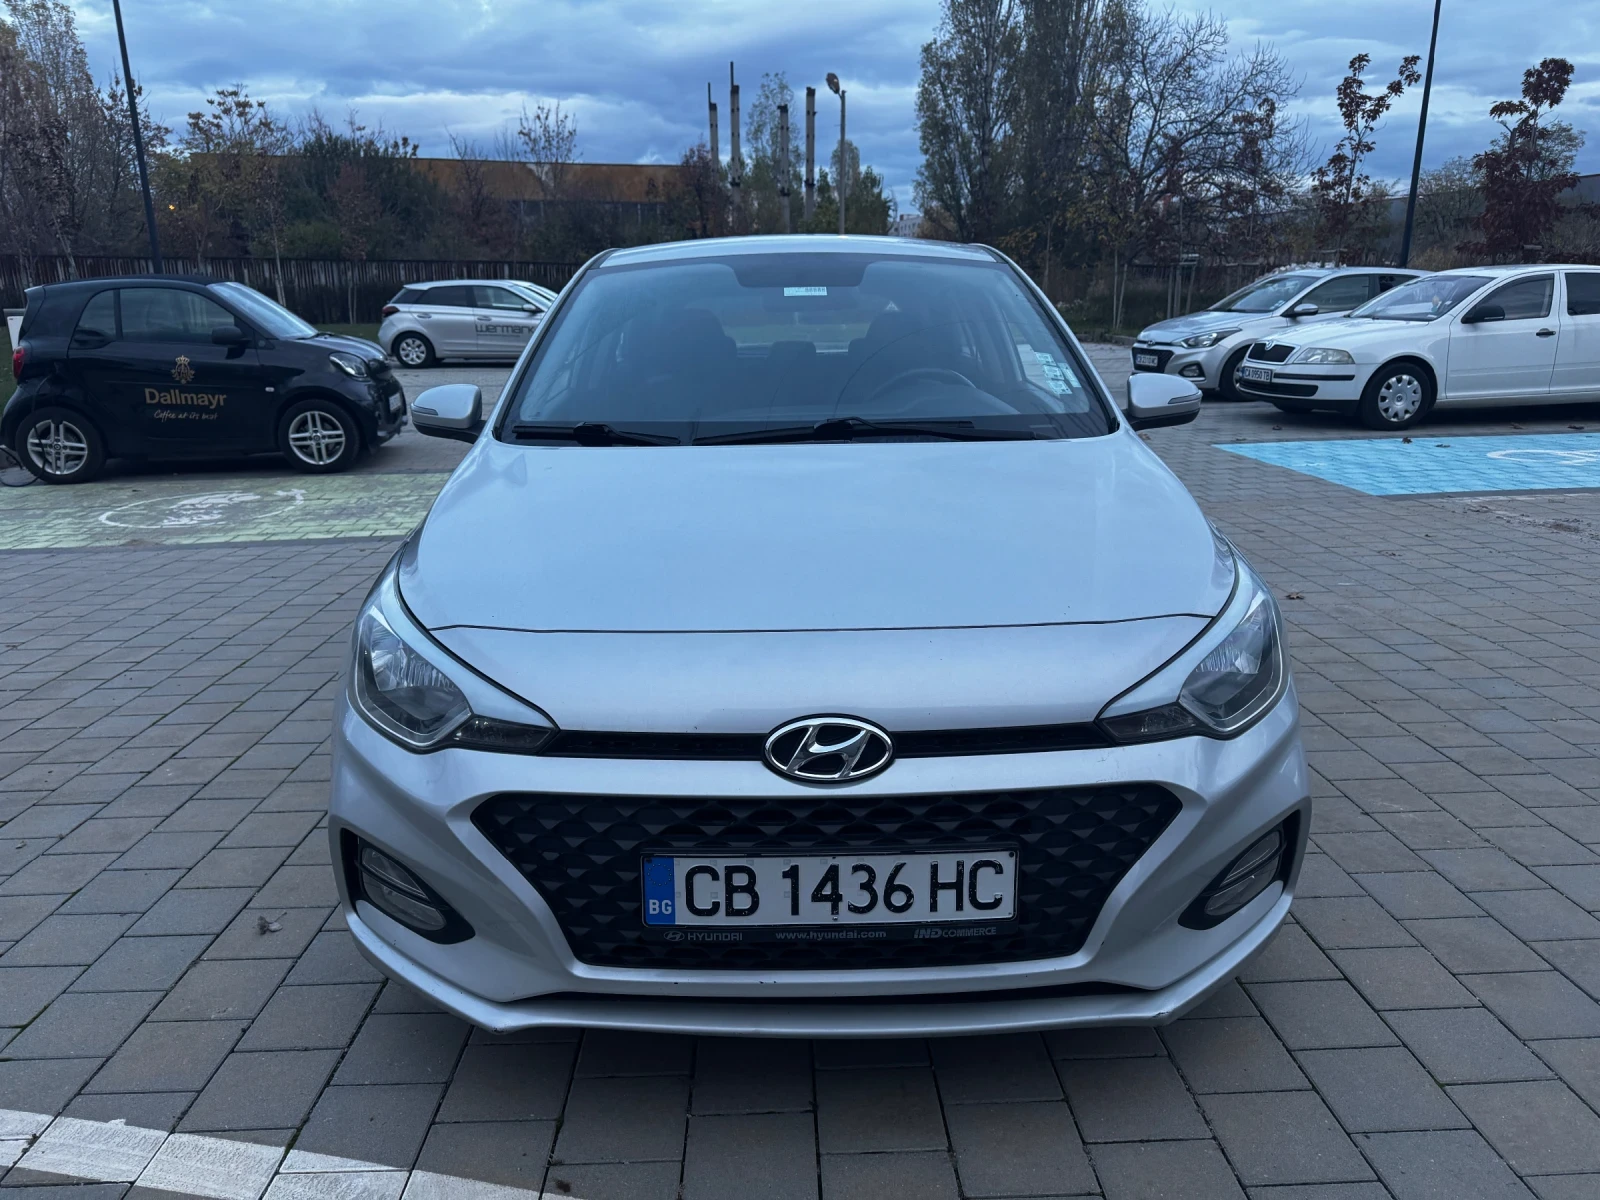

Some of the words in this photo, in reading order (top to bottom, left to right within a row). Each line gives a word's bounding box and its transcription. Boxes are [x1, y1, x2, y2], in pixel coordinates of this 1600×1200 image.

[1245, 368, 1251, 378] CA
[144, 387, 227, 409] Dallmayr
[154, 409, 177, 422] Coffee
[178, 411, 188, 420] at
[189, 411, 200, 420] its
[202, 412, 218, 420] best
[685, 865, 760, 916] CB
[782, 862, 915, 916] 1436
[930, 859, 1004, 912] HC
[649, 899, 672, 915] BG
[688, 932, 743, 941] HYUNDAI
[775, 930, 887, 941] www.hyundai.com
